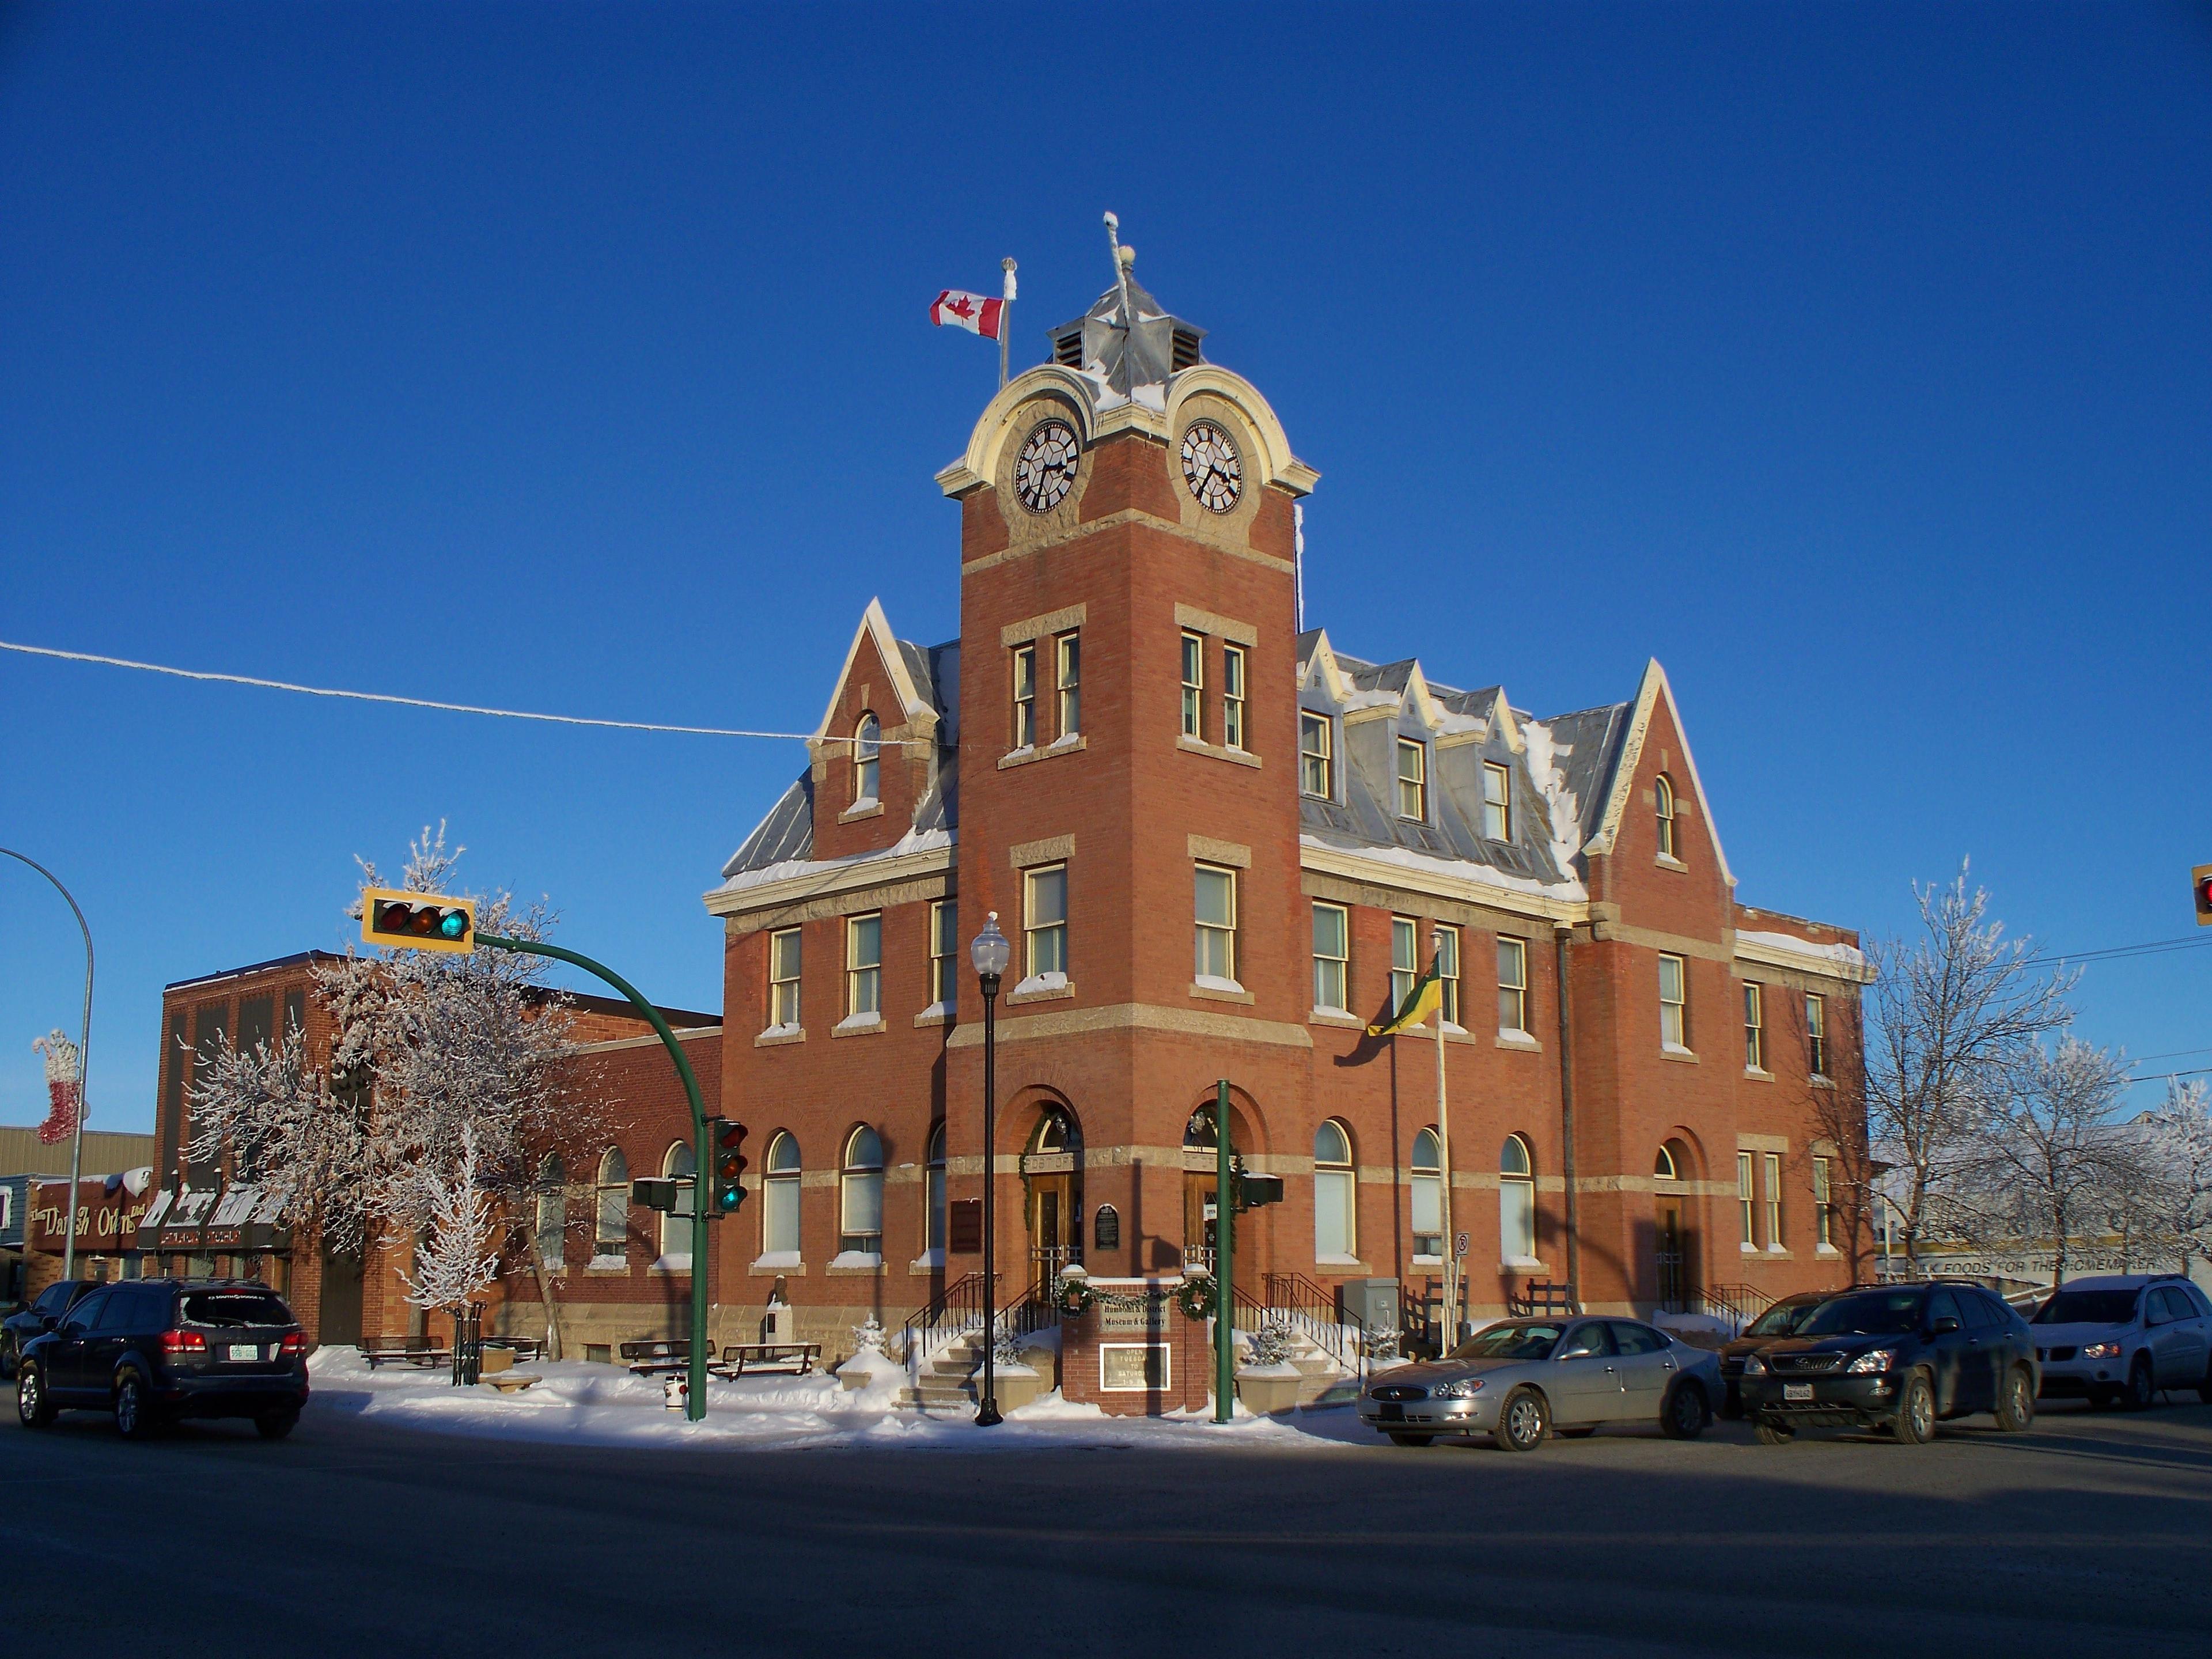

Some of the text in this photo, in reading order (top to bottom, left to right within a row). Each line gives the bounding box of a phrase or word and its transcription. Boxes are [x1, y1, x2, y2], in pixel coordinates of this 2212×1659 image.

[1025, 1157, 1051, 1169] POST
[45, 1205, 90, 1236] Dash
[1944, 1262, 1991, 1274] FOODS
[1997, 1261, 2024, 1273] FOR
[2032, 1260, 2056, 1272] THE
[2062, 1257, 2155, 1272] HOMEMAER
[1105, 1304, 1134, 1313] Humboldt
[1142, 1304, 1165, 1313] District
[1106, 1317, 1132, 1325] Museum
[1140, 1317, 1165, 1327] Gallery
